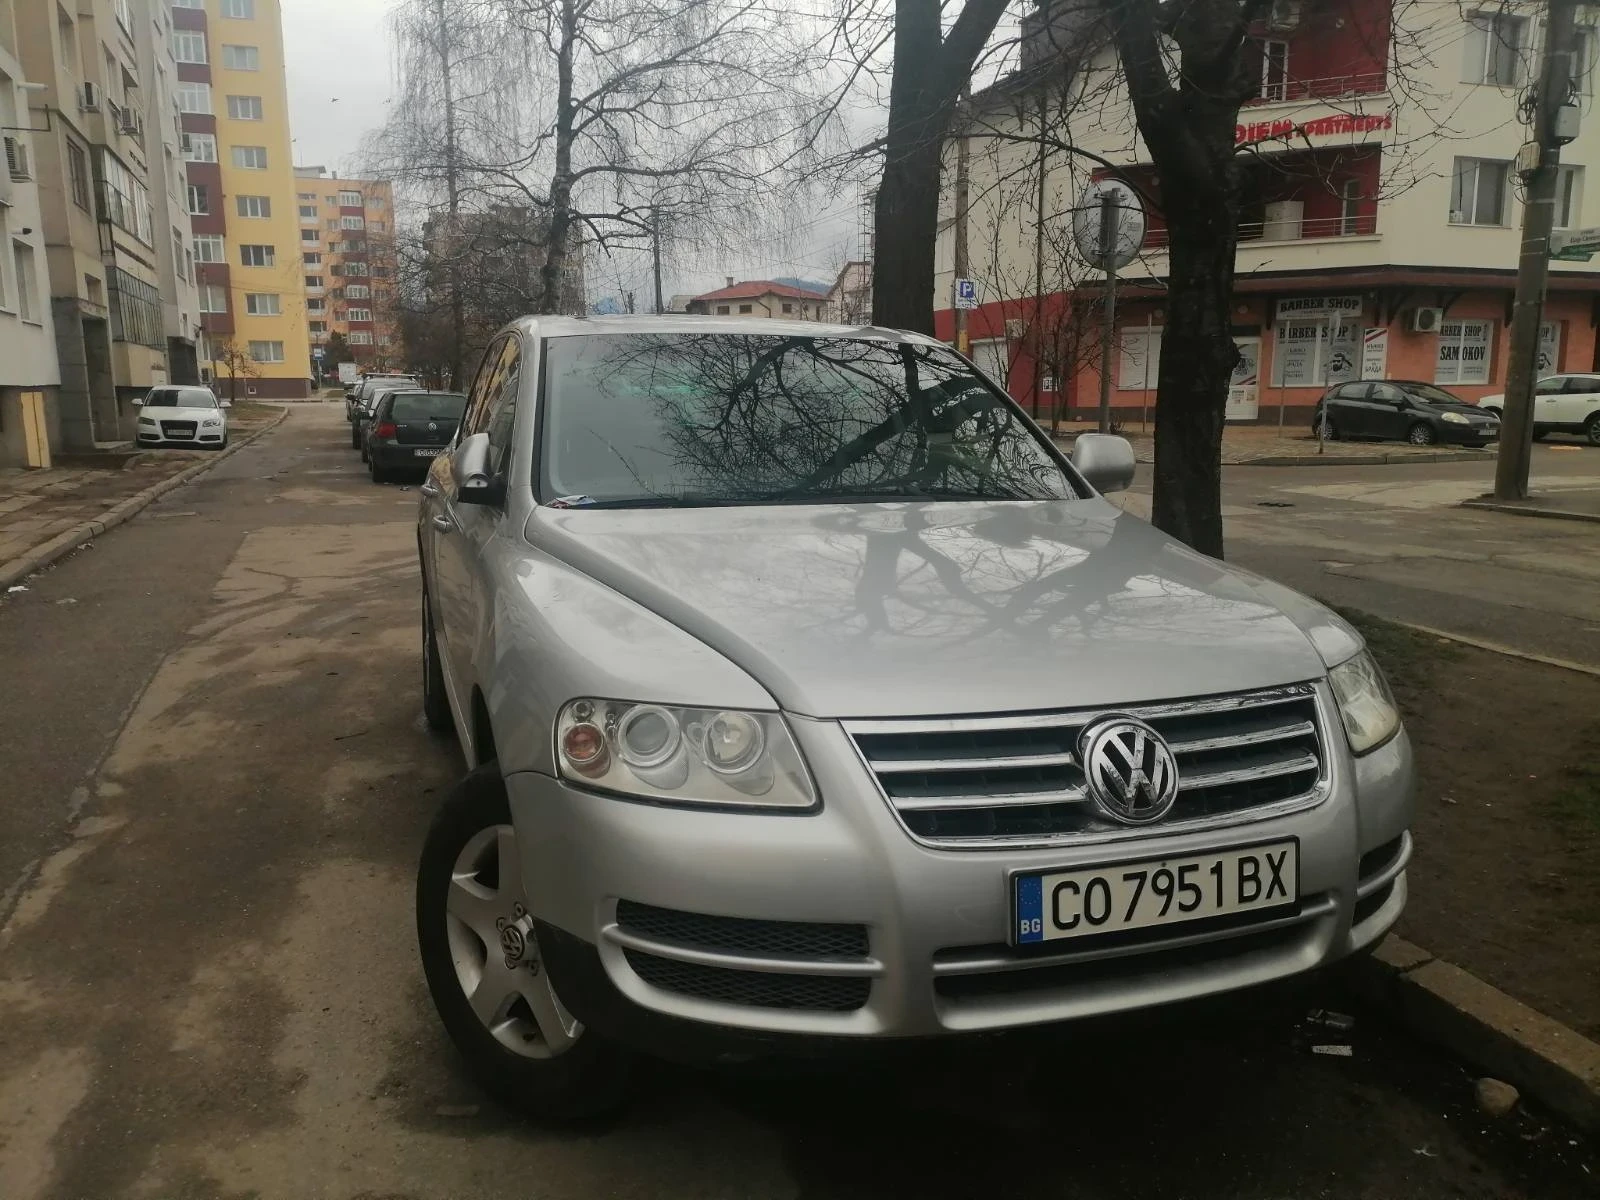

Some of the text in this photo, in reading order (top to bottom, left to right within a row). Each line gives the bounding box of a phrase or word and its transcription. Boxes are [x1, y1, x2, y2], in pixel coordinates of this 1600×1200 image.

[1280, 297, 1359, 312] BARBER SHOP
[1321, 326, 1349, 338] SP
[1440, 325, 1482, 337] ARBER SHOP
[1440, 346, 1486, 360] SAMOKOV
[1020, 918, 1041, 935] BG
